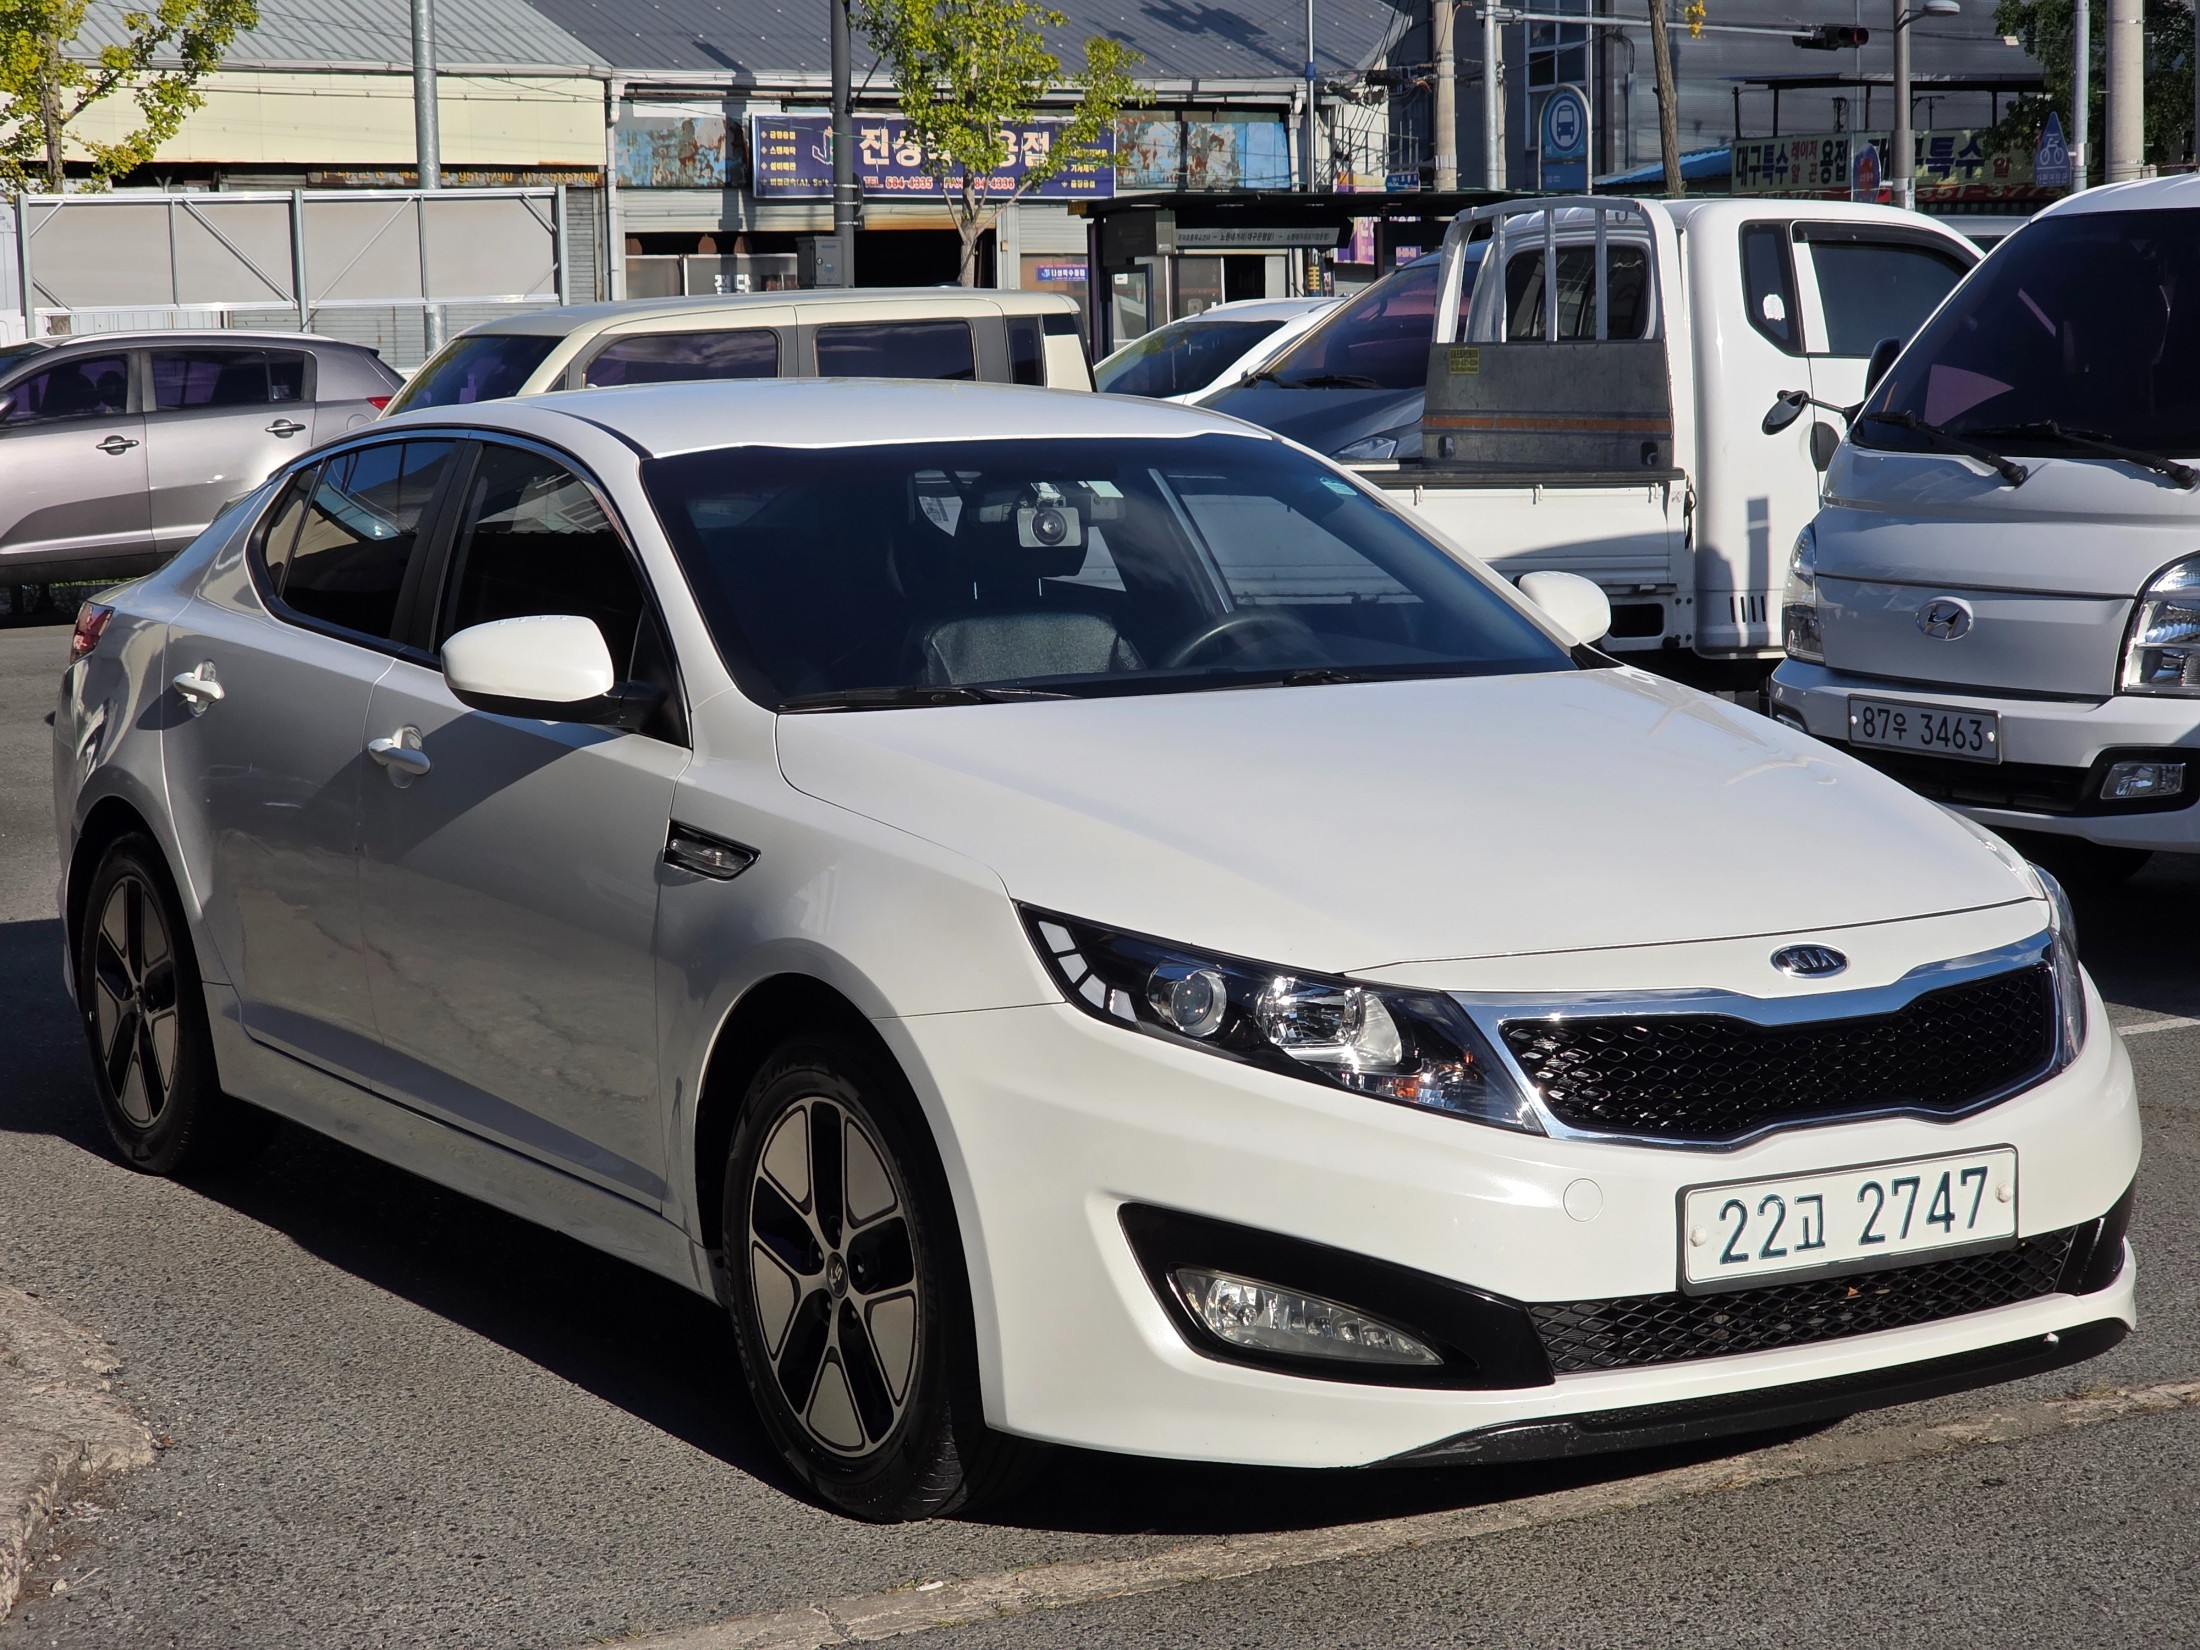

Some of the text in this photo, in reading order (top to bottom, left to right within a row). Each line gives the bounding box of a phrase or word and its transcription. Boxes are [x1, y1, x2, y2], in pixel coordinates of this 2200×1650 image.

[885, 176, 933, 190] 584-4335
[974, 176, 1015, 190] 84-4336
[1736, 139, 1849, 187] 대구특수 레이저 용접
[1863, 706, 1983, 752] 87우 3463
[1782, 948, 1840, 971] KIA
[1719, 1165, 1988, 1265] 22고 2747
